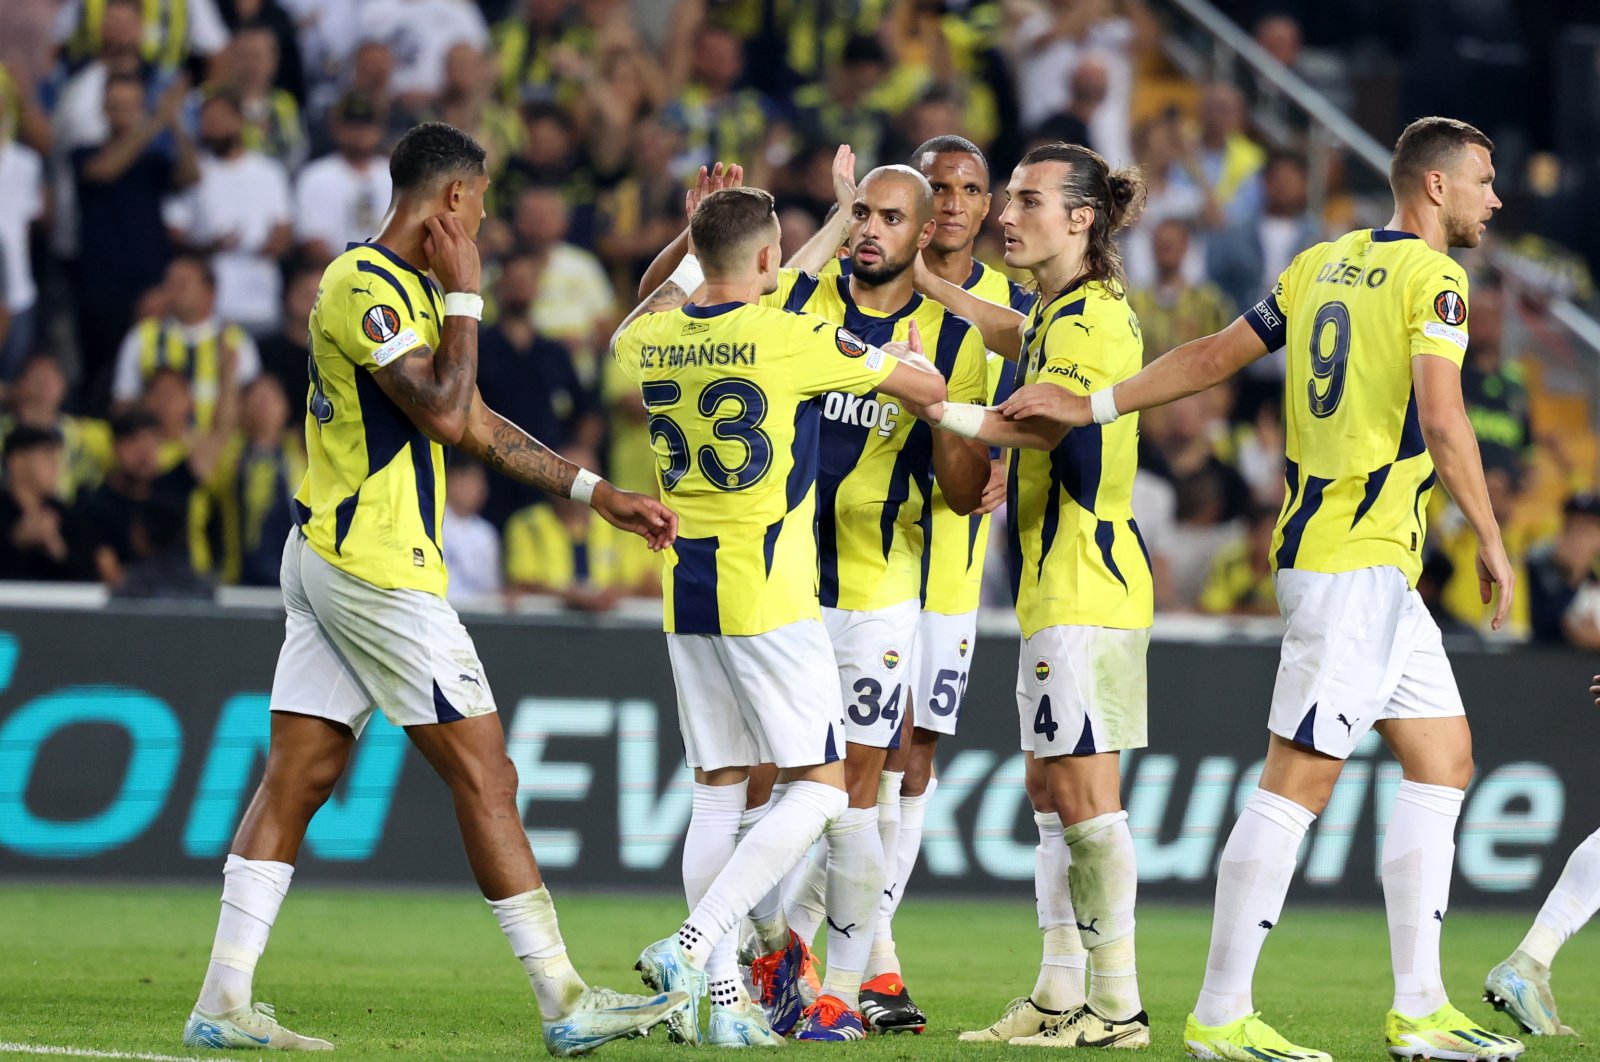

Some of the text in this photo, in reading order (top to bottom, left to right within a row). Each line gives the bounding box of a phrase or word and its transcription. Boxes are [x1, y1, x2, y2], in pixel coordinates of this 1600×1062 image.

[639, 337, 757, 369] SZYMAŃSKI
[1308, 300, 1352, 419] 9
[641, 376, 774, 492] 53
[847, 677, 901, 730] 34
[1033, 694, 1059, 743] 4
